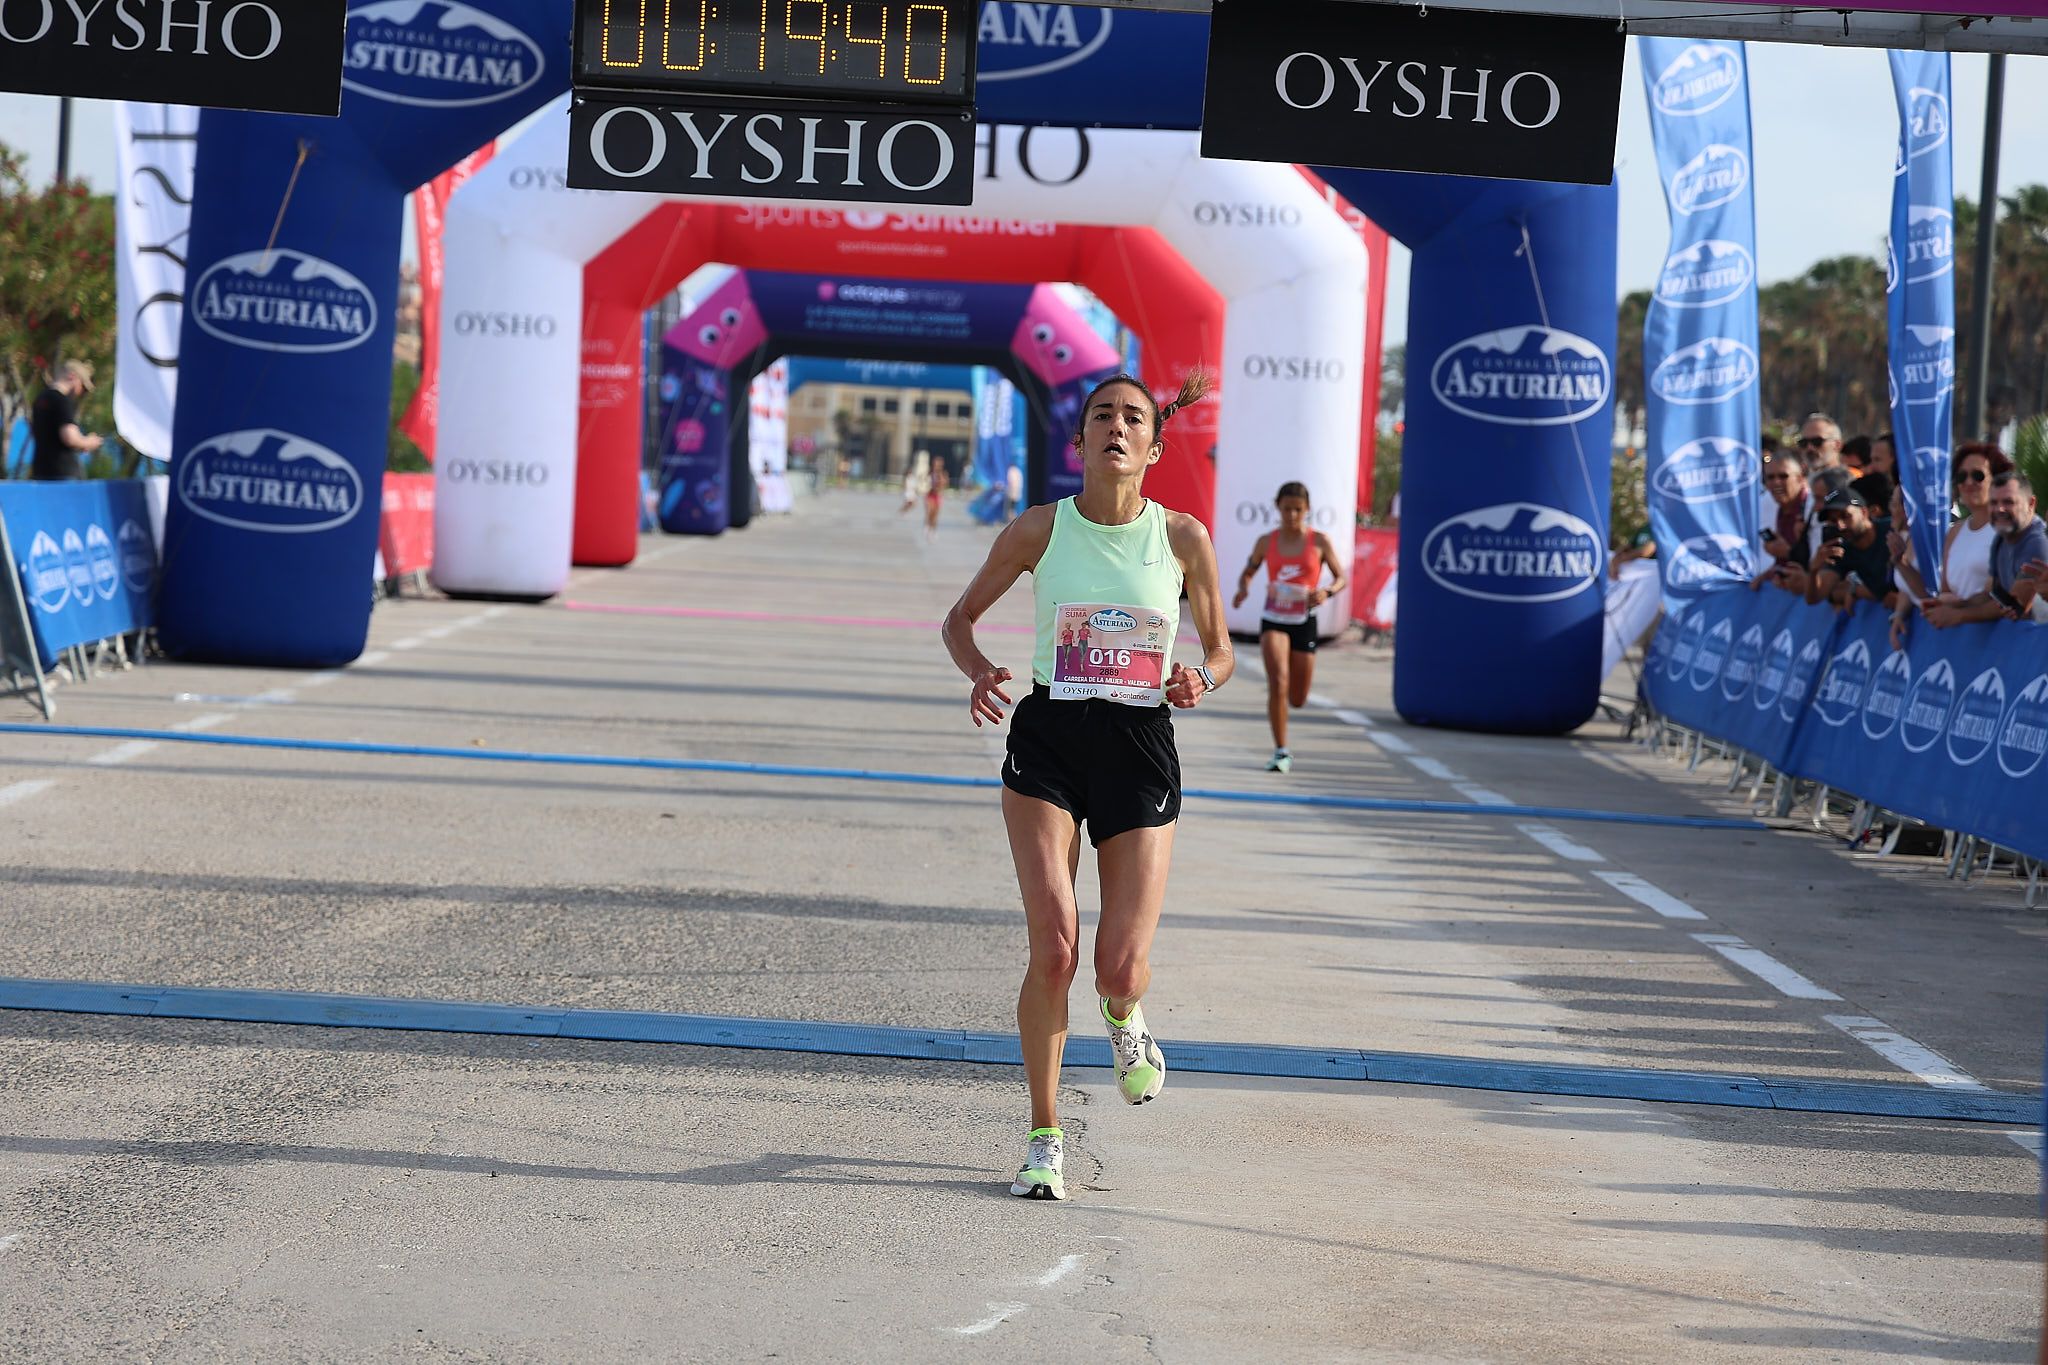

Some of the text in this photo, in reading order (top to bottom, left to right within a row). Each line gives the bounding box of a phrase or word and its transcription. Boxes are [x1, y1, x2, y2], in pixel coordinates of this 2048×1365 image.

[0, 0, 283, 61] OYSHO
[344, 40, 523, 87] STURIANA
[1275, 52, 1561, 129] OYSHO
[589, 106, 956, 192] OYSHO
[1194, 201, 1301, 228] OYSHO
[201, 279, 365, 335] ASTURIANA
[453, 310, 556, 338] OYSHO
[1243, 354, 1345, 384] OYSHO
[1443, 357, 1604, 401] ASTURIANA
[447, 459, 550, 487] OYSHO
[187, 459, 350, 523] ASTURIANA
[1235, 500, 1337, 527] OYO
[1433, 534, 1594, 578] ASTURIANA
[1092, 616, 1134, 628] ASTURIANA
[1089, 648, 1131, 667] 016
[1062, 686, 1098, 696] OYSHO
[1063, 675, 1088, 683] CARRERA
[1119, 692, 1151, 701] Santander
